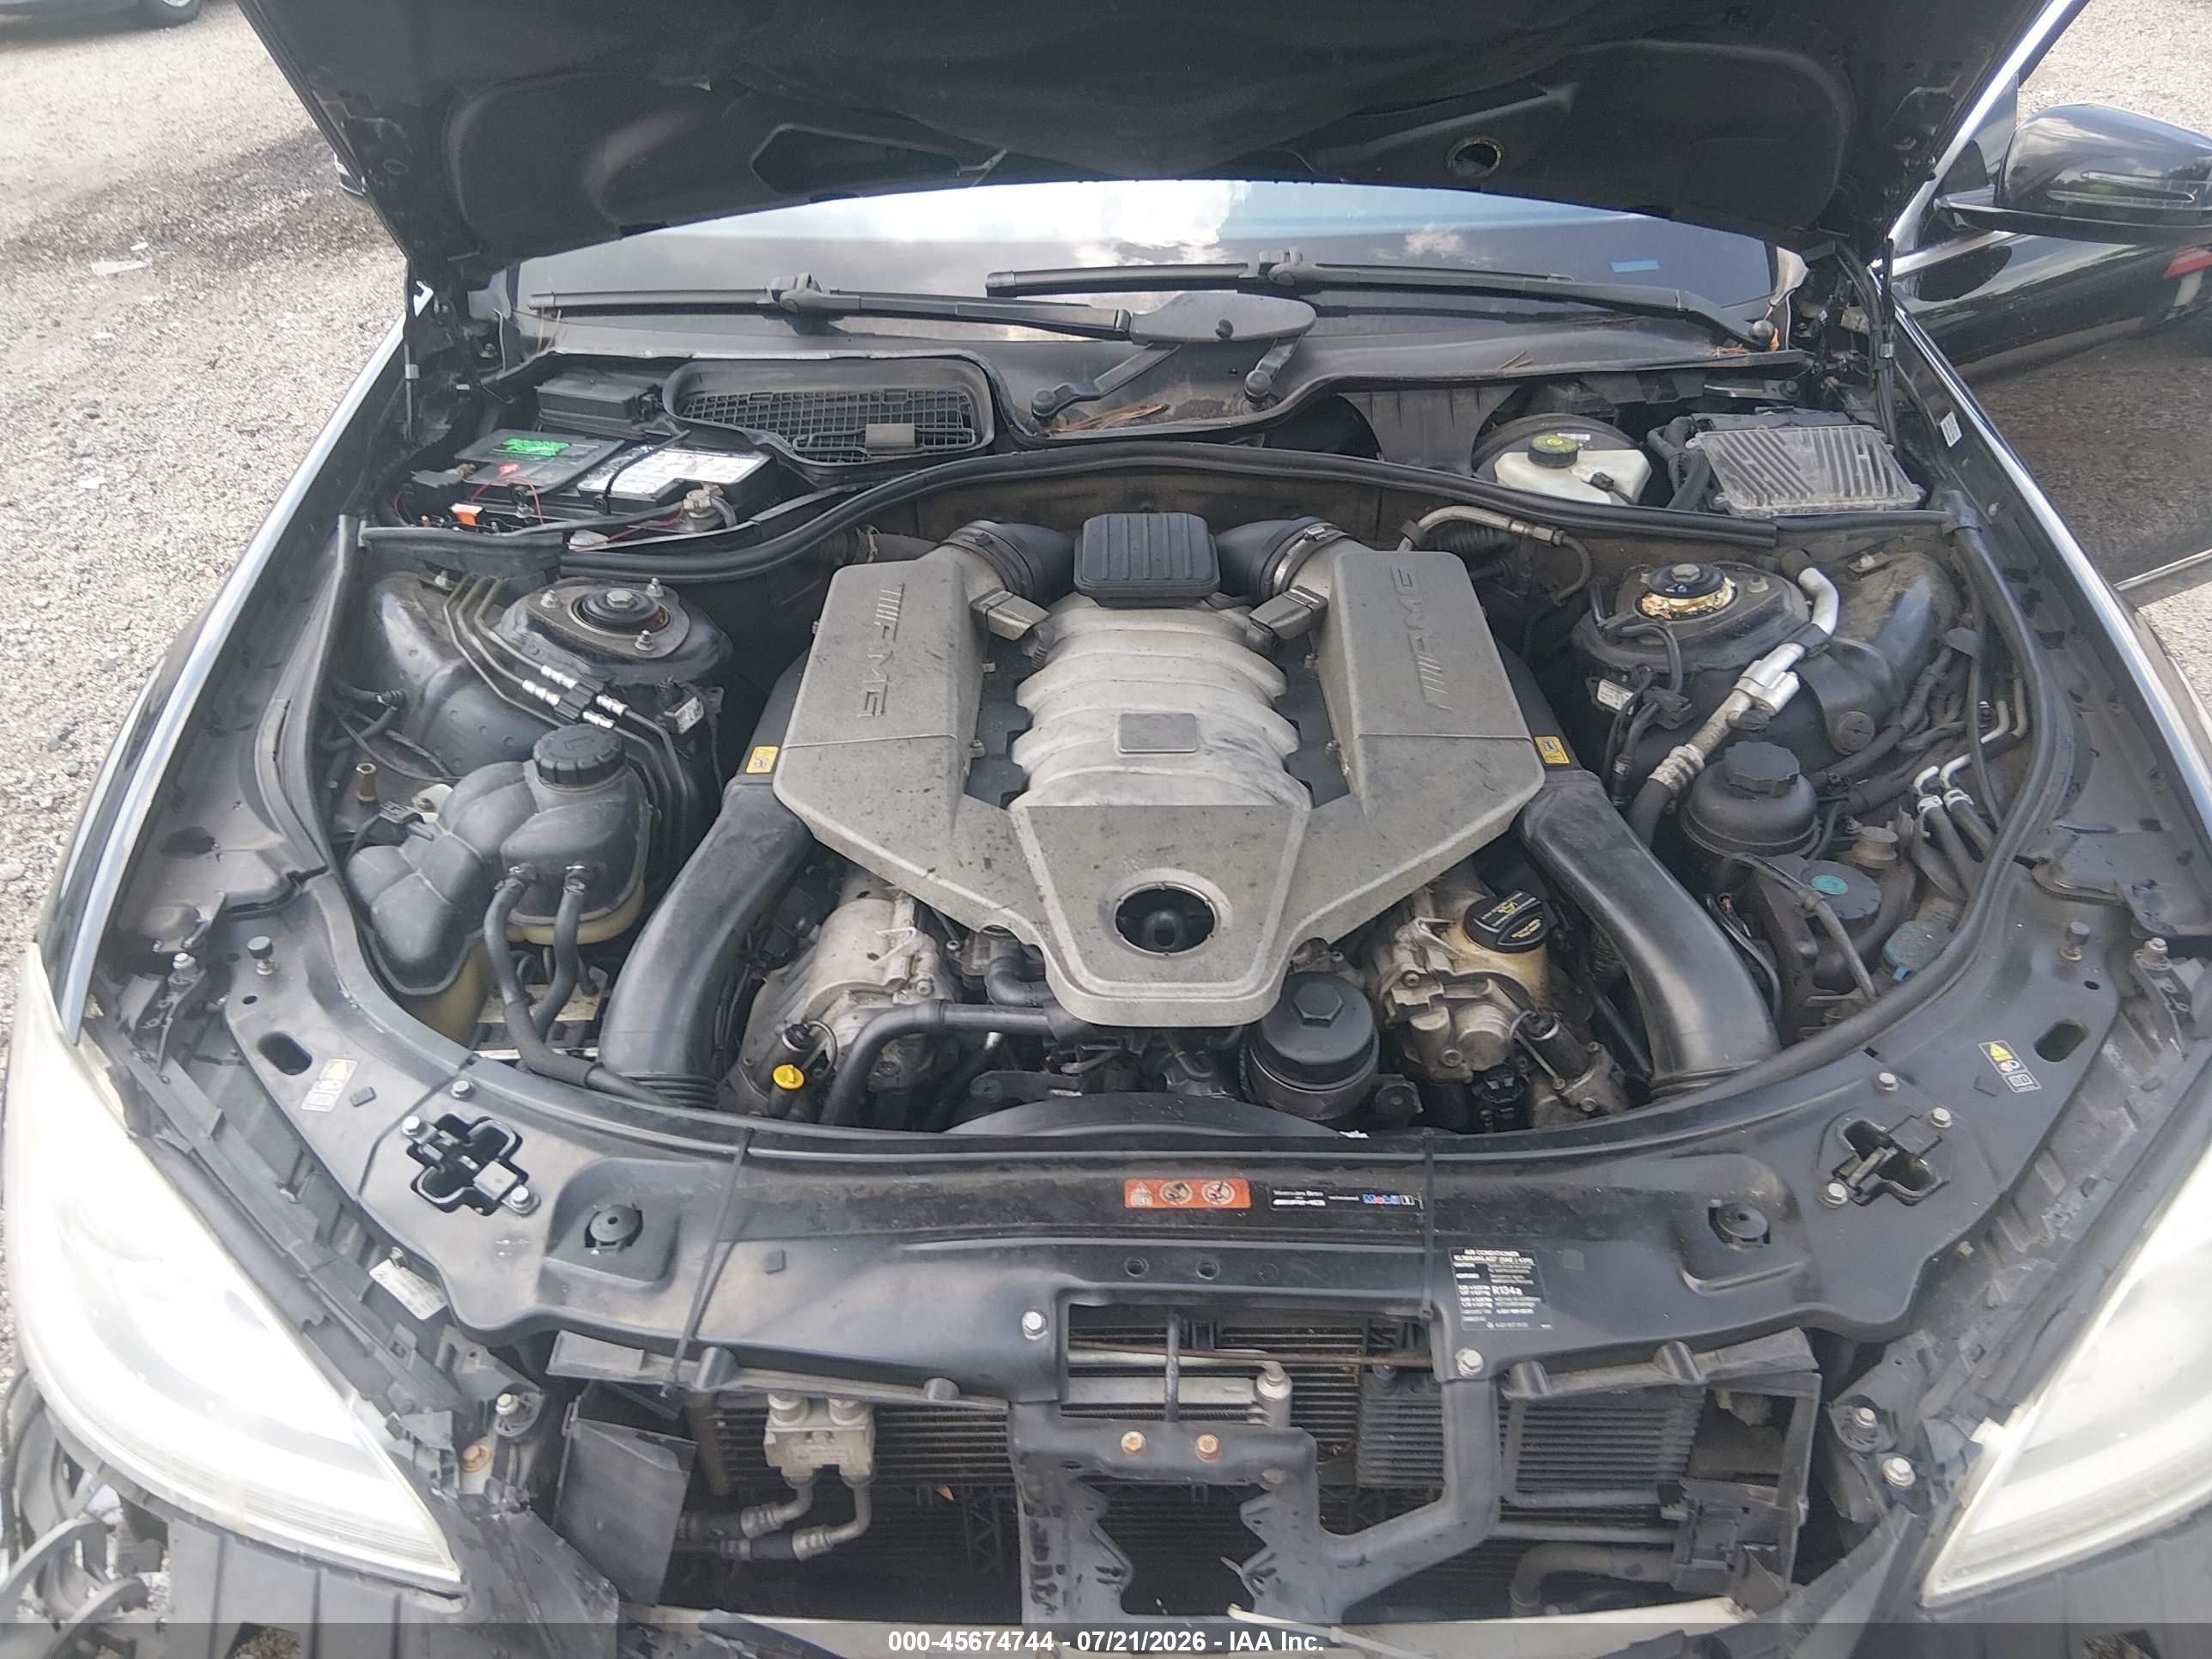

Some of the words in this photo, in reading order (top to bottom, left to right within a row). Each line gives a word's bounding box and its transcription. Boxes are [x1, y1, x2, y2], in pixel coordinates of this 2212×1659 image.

[857, 604, 899, 718] AMG
[1390, 567, 1442, 683] AMG
[1492, 1285, 1522, 1295] R134a
